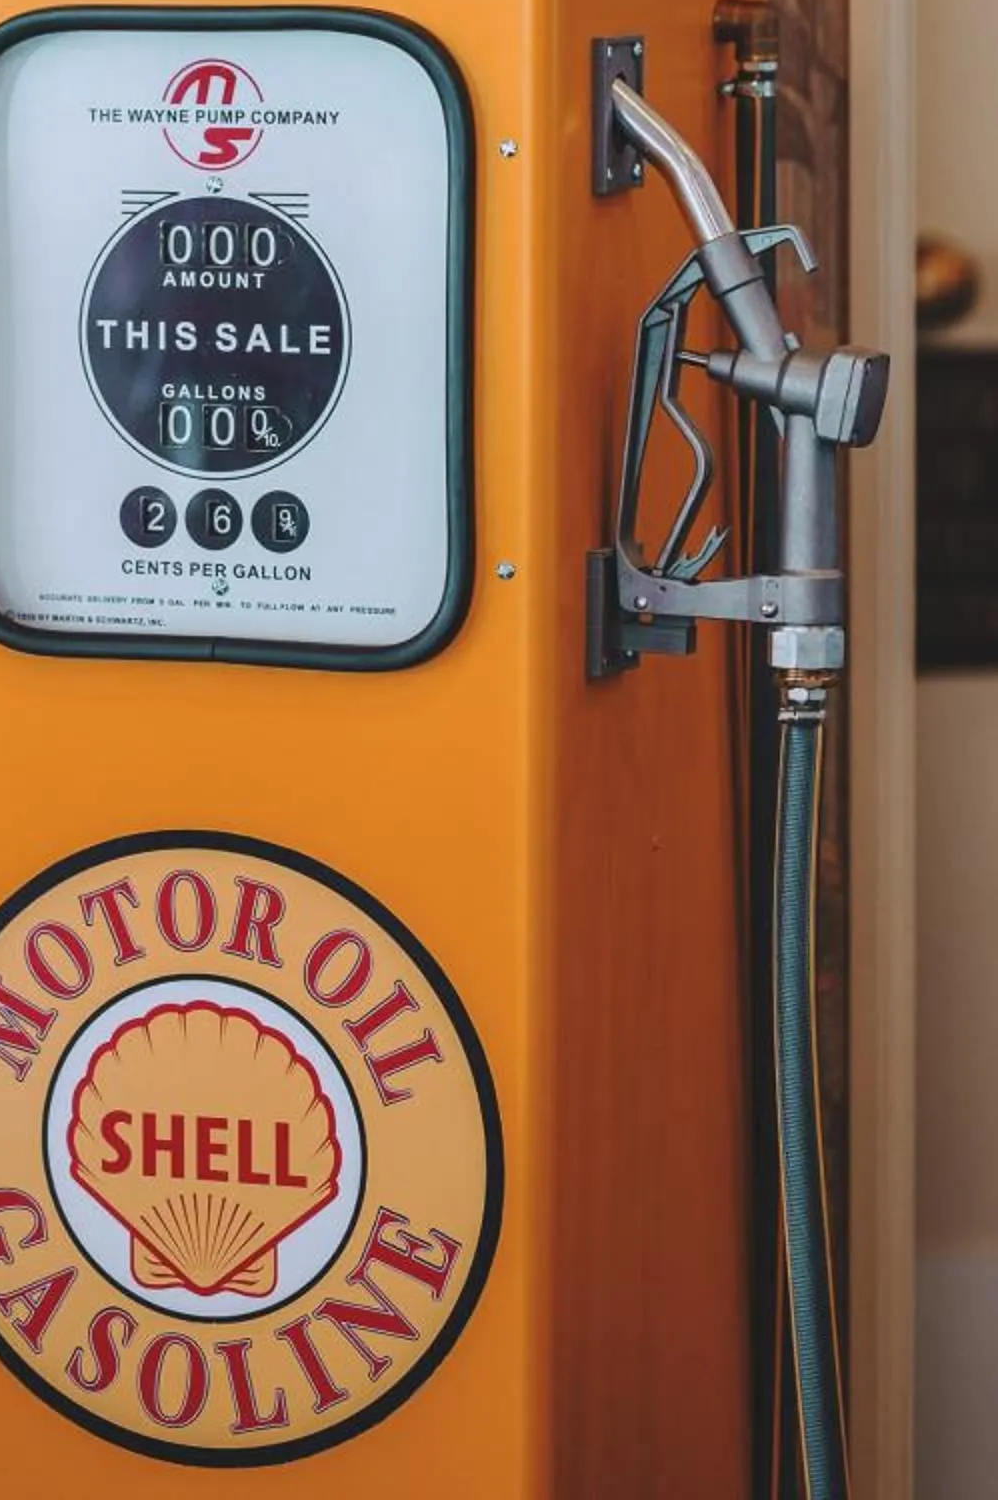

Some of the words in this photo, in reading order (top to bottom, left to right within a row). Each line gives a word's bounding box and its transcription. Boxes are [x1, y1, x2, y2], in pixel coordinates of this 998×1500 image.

[89, 108, 123, 123] THE
[128, 109, 189, 124] WAYNE
[195, 110, 246, 125] PUMP
[251, 110, 340, 126] COMPANY
[162, 271, 265, 289] AMOUNT
[96, 319, 198, 351] THIS
[215, 322, 332, 355] SALE
[162, 383, 267, 401] GALLONS
[121, 559, 183, 577] CENTS
[189, 563, 227, 578] PER
[233, 564, 311, 581] GALLON
[303, 927, 444, 1106] OIL
[101, 1110, 308, 1189] SHELL
